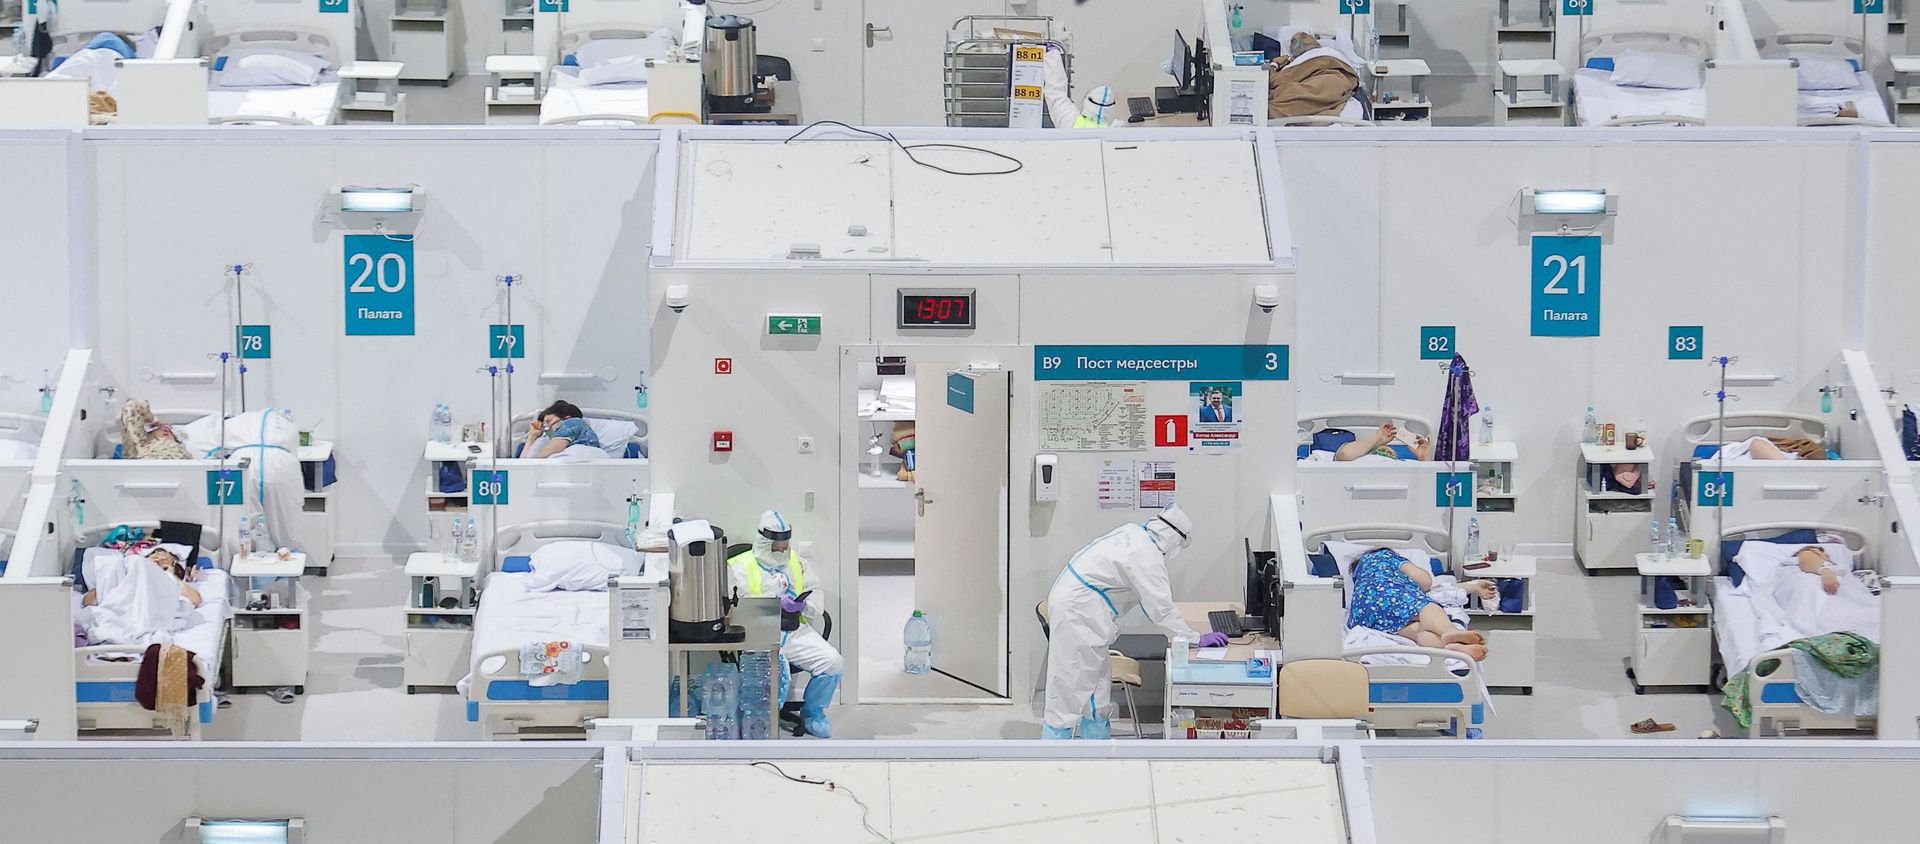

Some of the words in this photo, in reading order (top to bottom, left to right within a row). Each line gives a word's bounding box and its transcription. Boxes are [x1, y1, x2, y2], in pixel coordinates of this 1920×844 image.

[349, 253, 406, 293] 20
[1543, 254, 1586, 294] 21
[358, 307, 403, 319] Палата
[1543, 309, 1588, 321] Палата
[242, 335, 262, 351] 78
[496, 335, 517, 351] 79
[1428, 336, 1449, 352] 82
[1675, 336, 1697, 352] 83
[1077, 356, 1112, 369] Пост
[1116, 359, 1197, 372] медсестры
[1265, 352, 1278, 371] 3
[215, 480, 235, 497] 77
[478, 480, 502, 497] 80
[1445, 481, 1463, 497] 81
[1704, 481, 1727, 498] 84
